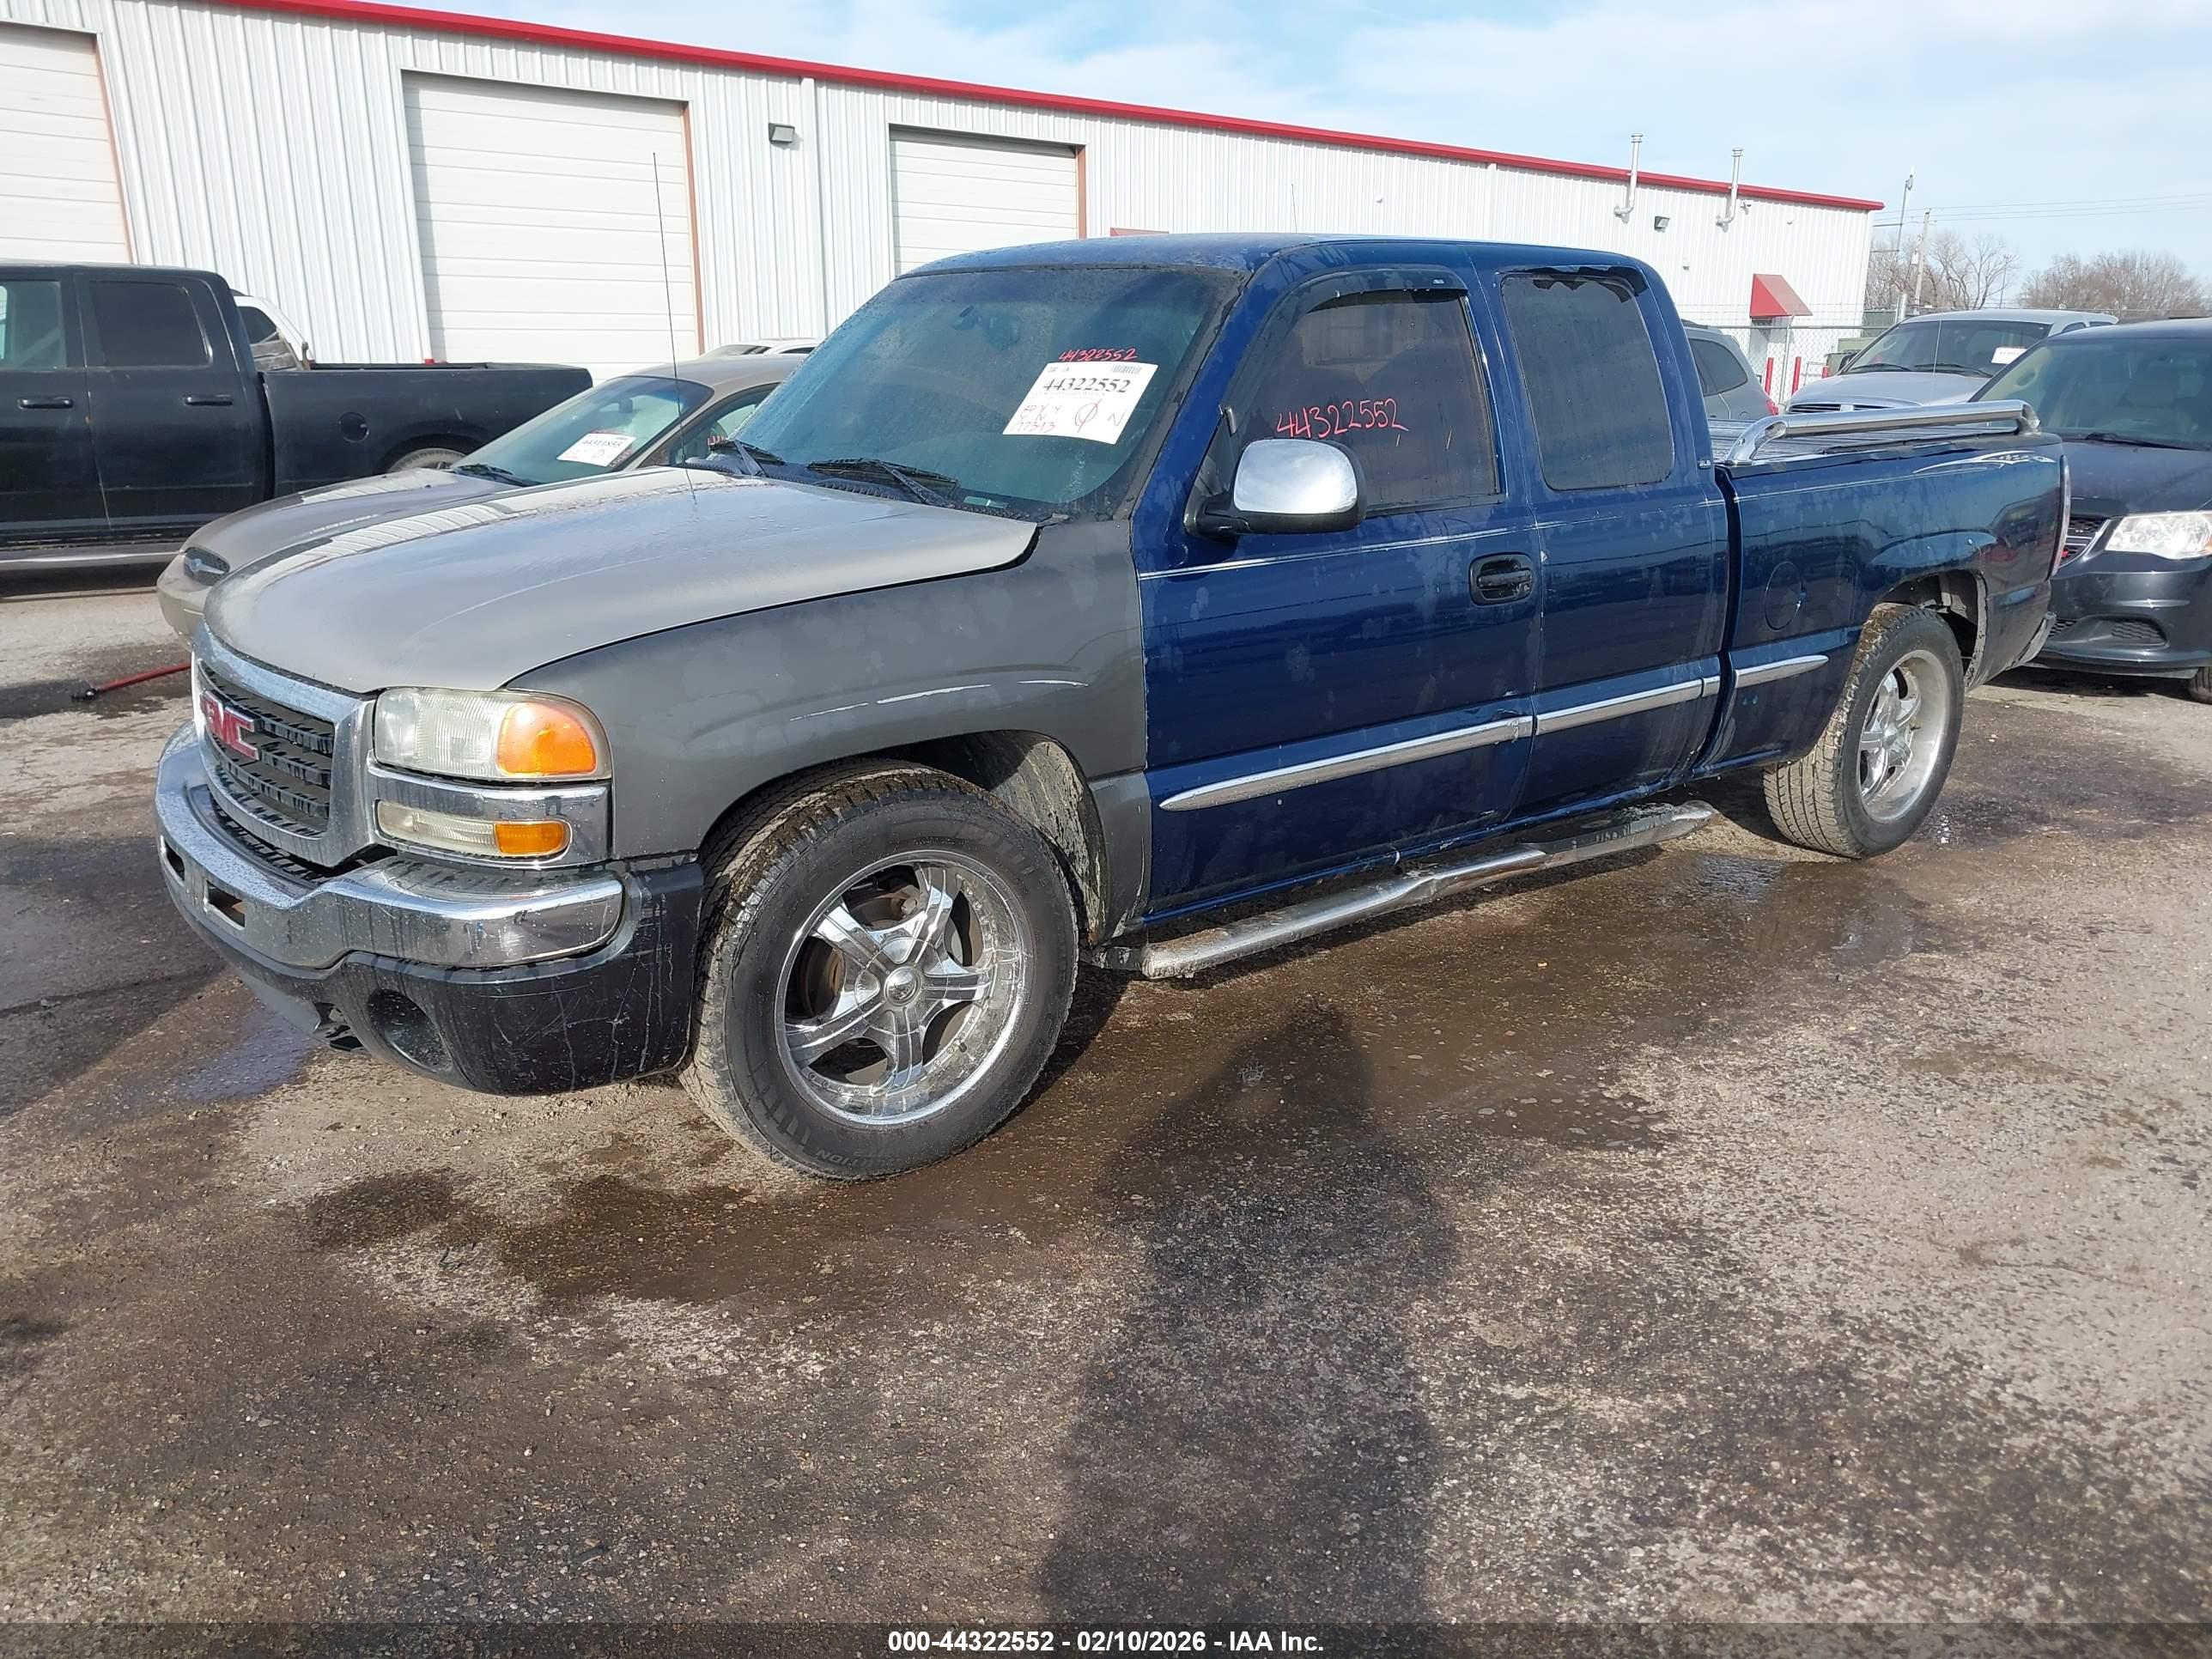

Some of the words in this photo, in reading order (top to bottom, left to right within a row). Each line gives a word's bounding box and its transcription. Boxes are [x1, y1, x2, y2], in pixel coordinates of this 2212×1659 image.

[1058, 349, 1138, 361] 44322552
[1043, 378, 1131, 392] 44322552
[1277, 398, 1409, 439] 44322552
[200, 690, 259, 761] GMC
